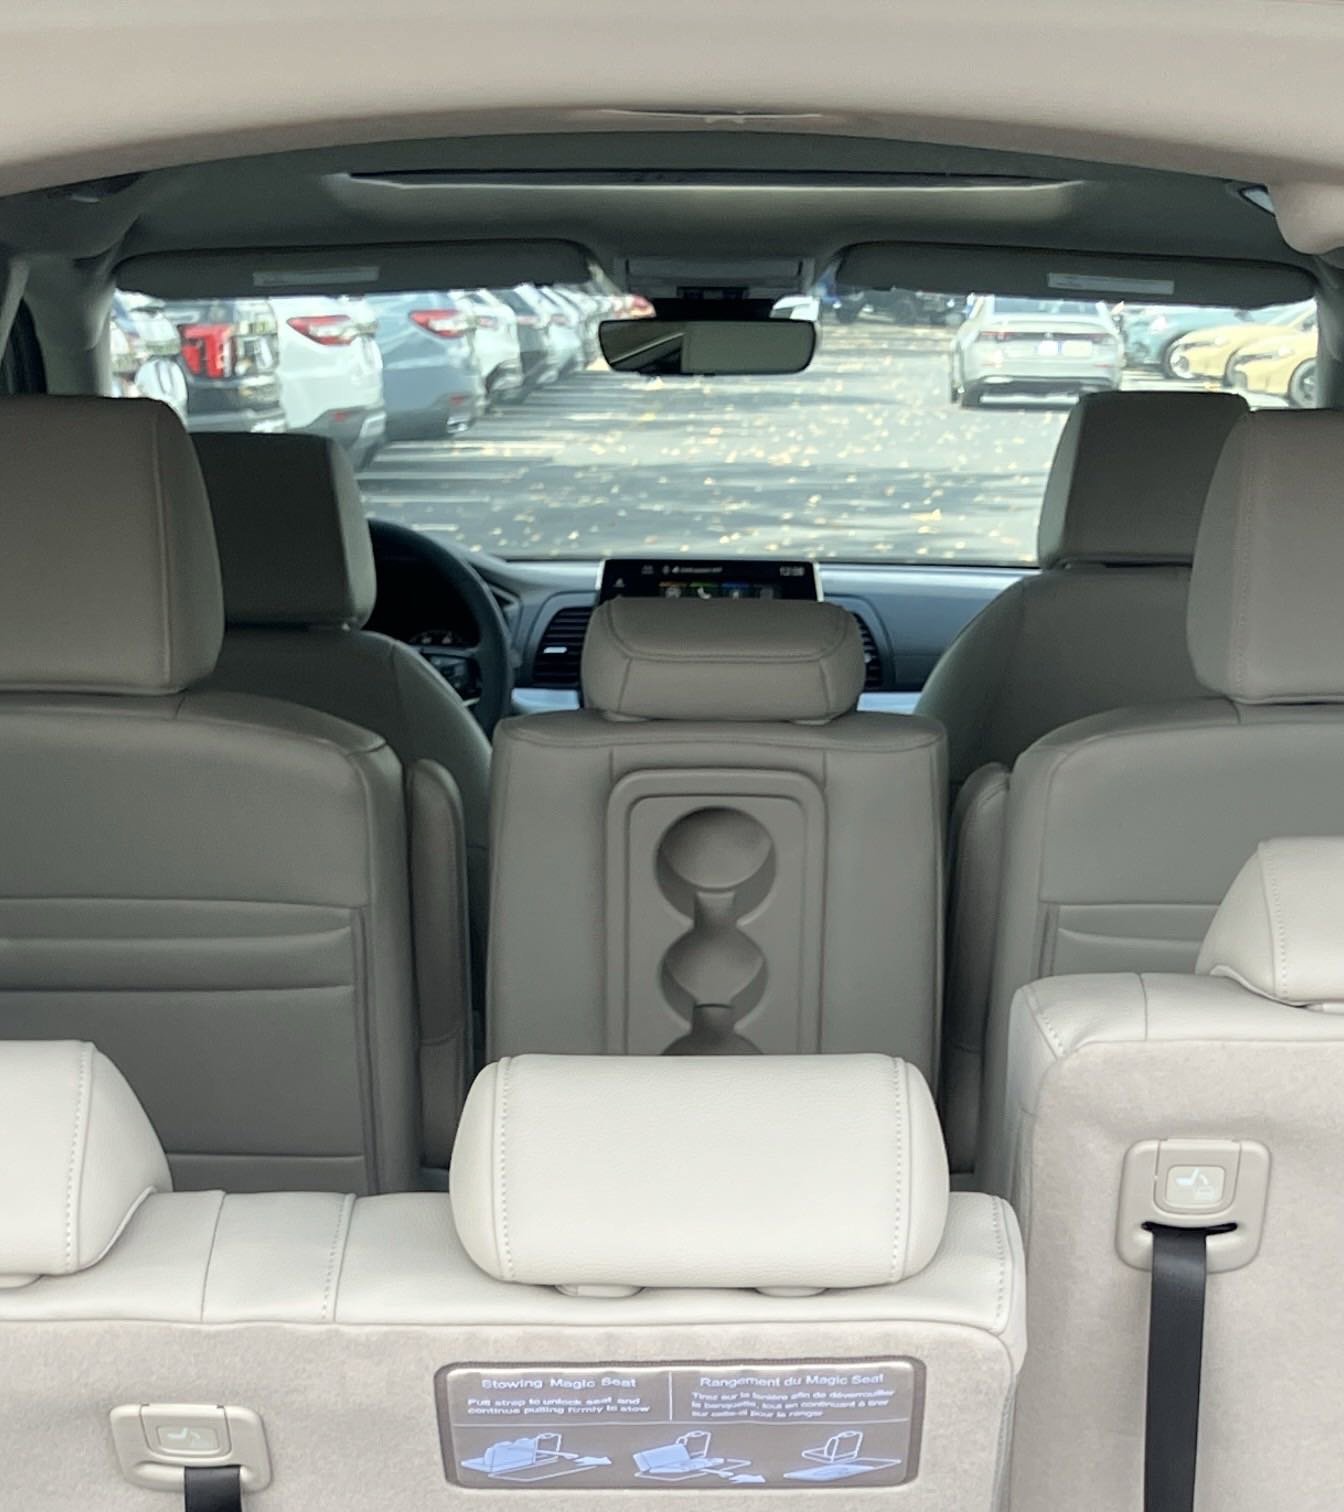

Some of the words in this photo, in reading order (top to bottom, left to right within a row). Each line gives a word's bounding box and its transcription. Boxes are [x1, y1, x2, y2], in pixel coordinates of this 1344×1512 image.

[481, 1378, 543, 1389] Stowing
[550, 1378, 596, 1389] Magic
[601, 1376, 637, 1388] Seat
[700, 1376, 780, 1388] Rangement
[784, 1376, 801, 1386] du
[806, 1375, 847, 1387] Magic
[851, 1374, 884, 1385] Seat
[529, 1398, 541, 1406] to
[617, 1397, 641, 1405] and
[468, 1407, 521, 1415] continue
[524, 1406, 565, 1415] pulling
[620, 1405, 651, 1413] stow
